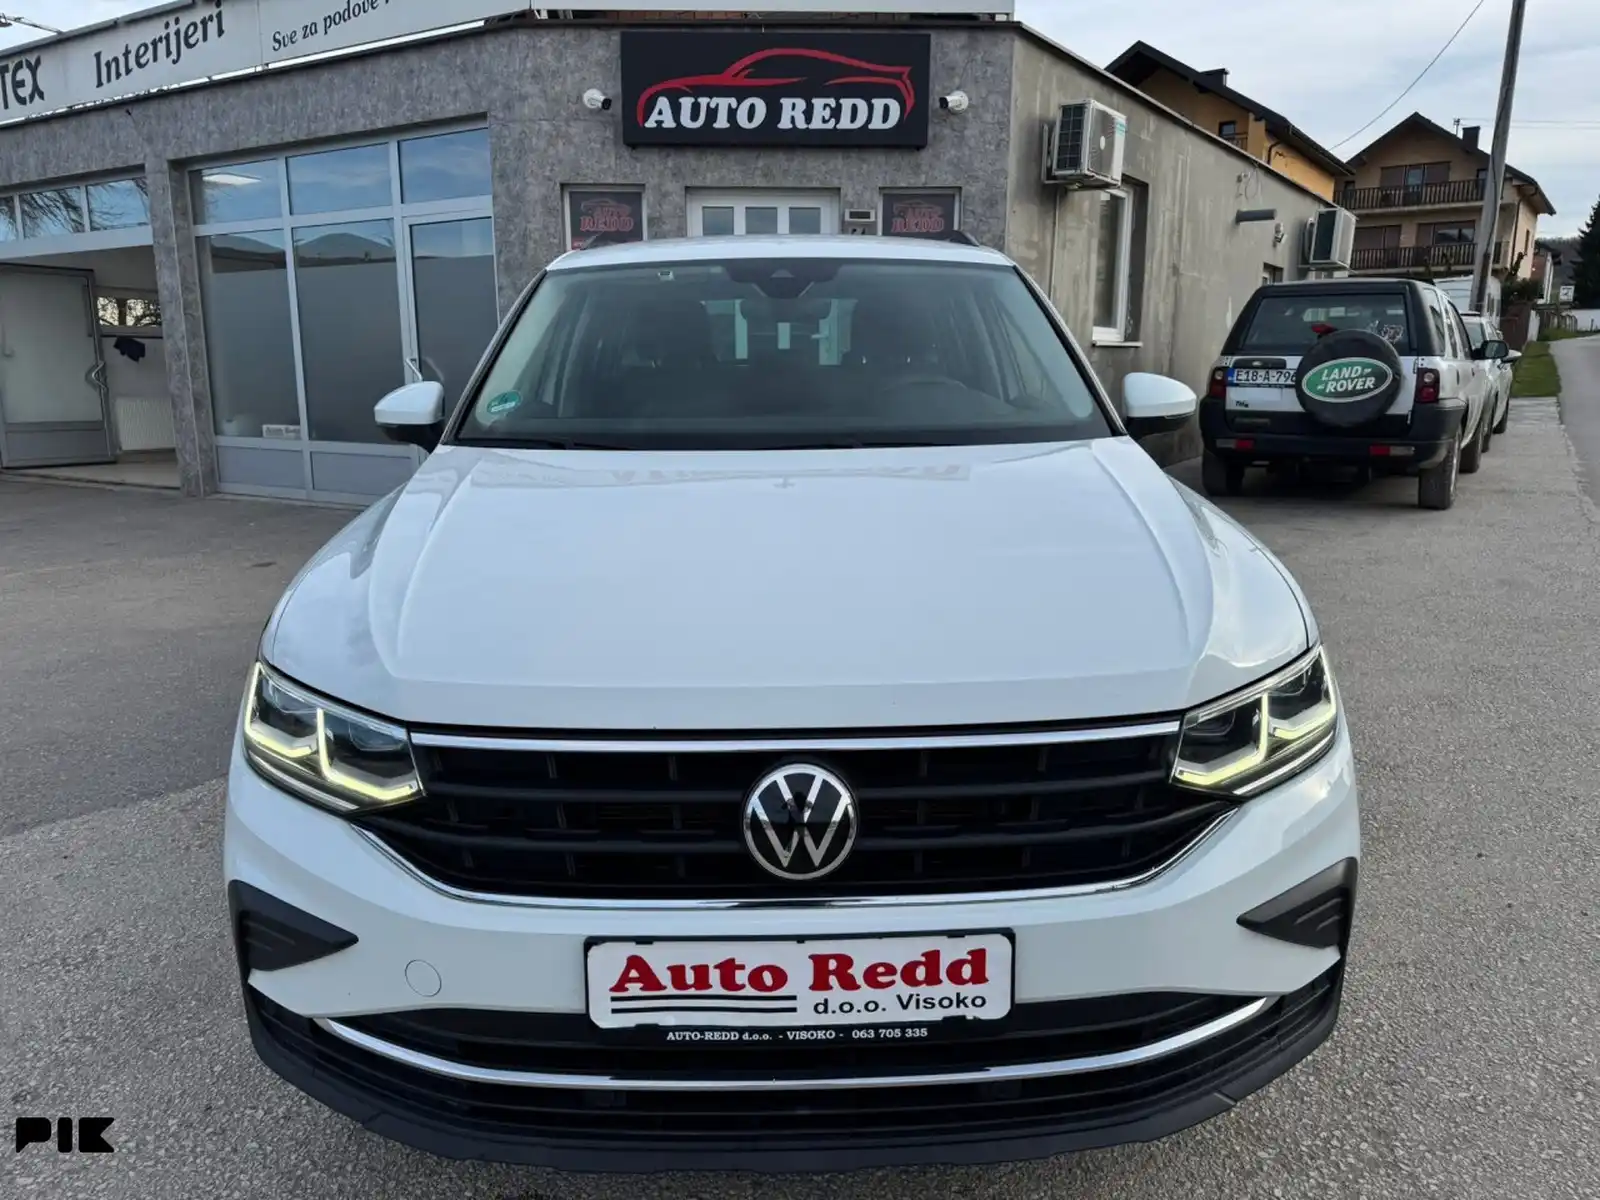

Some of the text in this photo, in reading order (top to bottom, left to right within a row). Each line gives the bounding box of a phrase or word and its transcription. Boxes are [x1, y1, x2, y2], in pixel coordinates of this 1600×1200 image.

[272, 0, 380, 52] Sve za podove
[94, 0, 225, 88] Interijeri
[644, 95, 901, 130] AUTO REDD
[1321, 366, 1362, 381] LAND
[1326, 376, 1376, 393] ROVER
[609, 948, 990, 993] Auto Redd
[813, 992, 987, 1015] d.o.o. Visoko
[666, 1031, 740, 1041] AUTO-REDD
[742, 1031, 773, 1041] d.o.o.
[786, 1029, 836, 1040] VISOKO
[851, 1029, 875, 1039] 063
[878, 1028, 902, 1038] 705
[904, 1027, 928, 1037] 335
